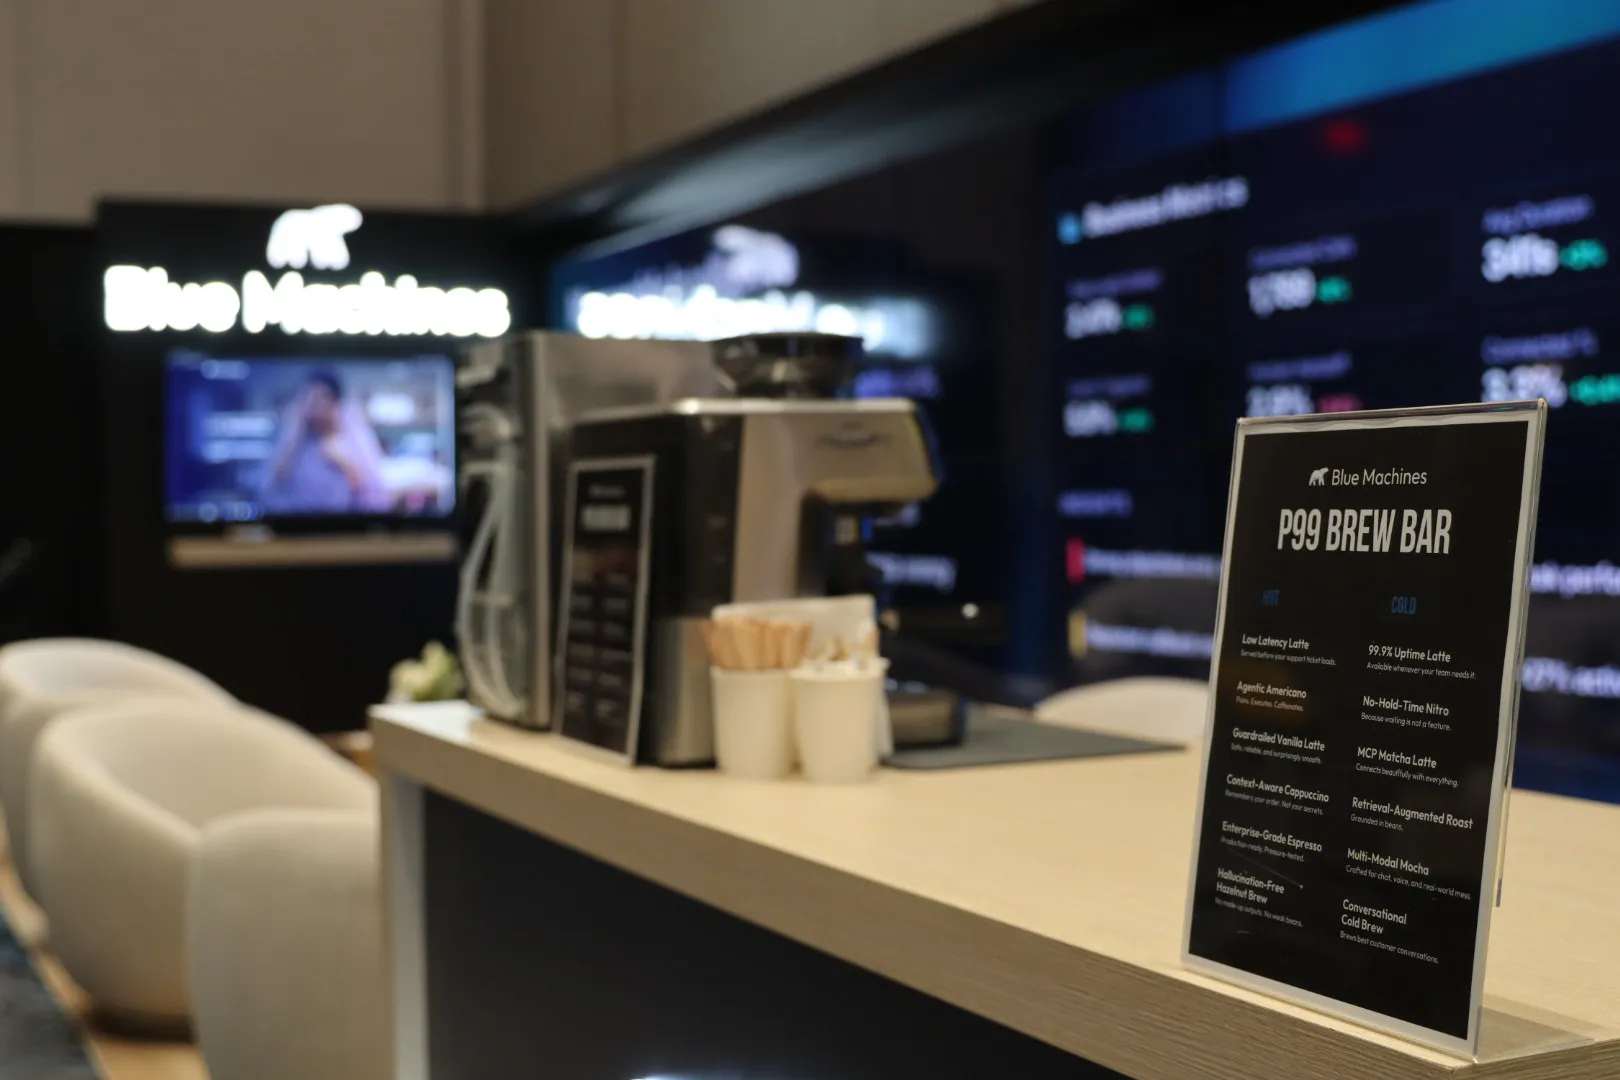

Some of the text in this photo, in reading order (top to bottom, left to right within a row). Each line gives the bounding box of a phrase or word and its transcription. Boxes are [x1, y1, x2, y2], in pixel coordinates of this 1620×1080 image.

[104, 265, 240, 332] Blue
[242, 271, 510, 338] Machines
[1332, 468, 1427, 486] Blue Machines
[1278, 508, 1452, 554] P99 BREW BAR
[1391, 596, 1417, 614] COLD
[1242, 634, 1309, 650] Low Latency Latte
[1241, 649, 1257, 657] Served
[1258, 651, 1274, 659] before
[1321, 657, 1336, 665] loads.
[1369, 645, 1451, 662] 99.9% Uptime Latte
[1367, 662, 1392, 671] Available
[1393, 664, 1420, 674] whenever
[1237, 680, 1306, 698] Agentic Americano
[1363, 696, 1449, 716] No-Hold-Time Nitro
[1361, 712, 1384, 722] Because
[1385, 717, 1405, 726] waiting
[1428, 721, 1451, 731] feature.
[1233, 728, 1325, 751] Guardrailed Vanilla Latte
[1274, 751, 1301, 762] surprisingly
[1357, 747, 1436, 768] MCP Matcha Latte
[1356, 763, 1458, 788] Connects beautifully with everything.
[1227, 774, 1329, 802] Context-Aware Cappuccino
[1266, 798, 1280, 806] order.
[1292, 803, 1303, 811] your
[1304, 806, 1323, 814] secrets.
[1352, 797, 1473, 829] Retrieval-Augmented Roast
[1351, 814, 1378, 826] Grounded
[1385, 821, 1403, 831] beans.
[1222, 821, 1322, 852] Enterprise-Grade Espresso
[1265, 846, 1304, 862] Pressure-tested.
[1347, 848, 1429, 875] Multi-Modal Mocha
[1218, 868, 1284, 893] Hallucination-Free
[1346, 865, 1471, 900] Crafted for chat, voice, and real-world mess.
[1216, 881, 1267, 903] Hazelnut Brew
[1215, 897, 1222, 905] No
[1264, 910, 1271, 918] No
[1273, 914, 1285, 922] weak
[1286, 917, 1303, 927] beans.
[1343, 899, 1407, 924] Conversational
[1341, 914, 1384, 934] Cold Brew
[1340, 931, 1439, 964] Brews best customer conversations.
